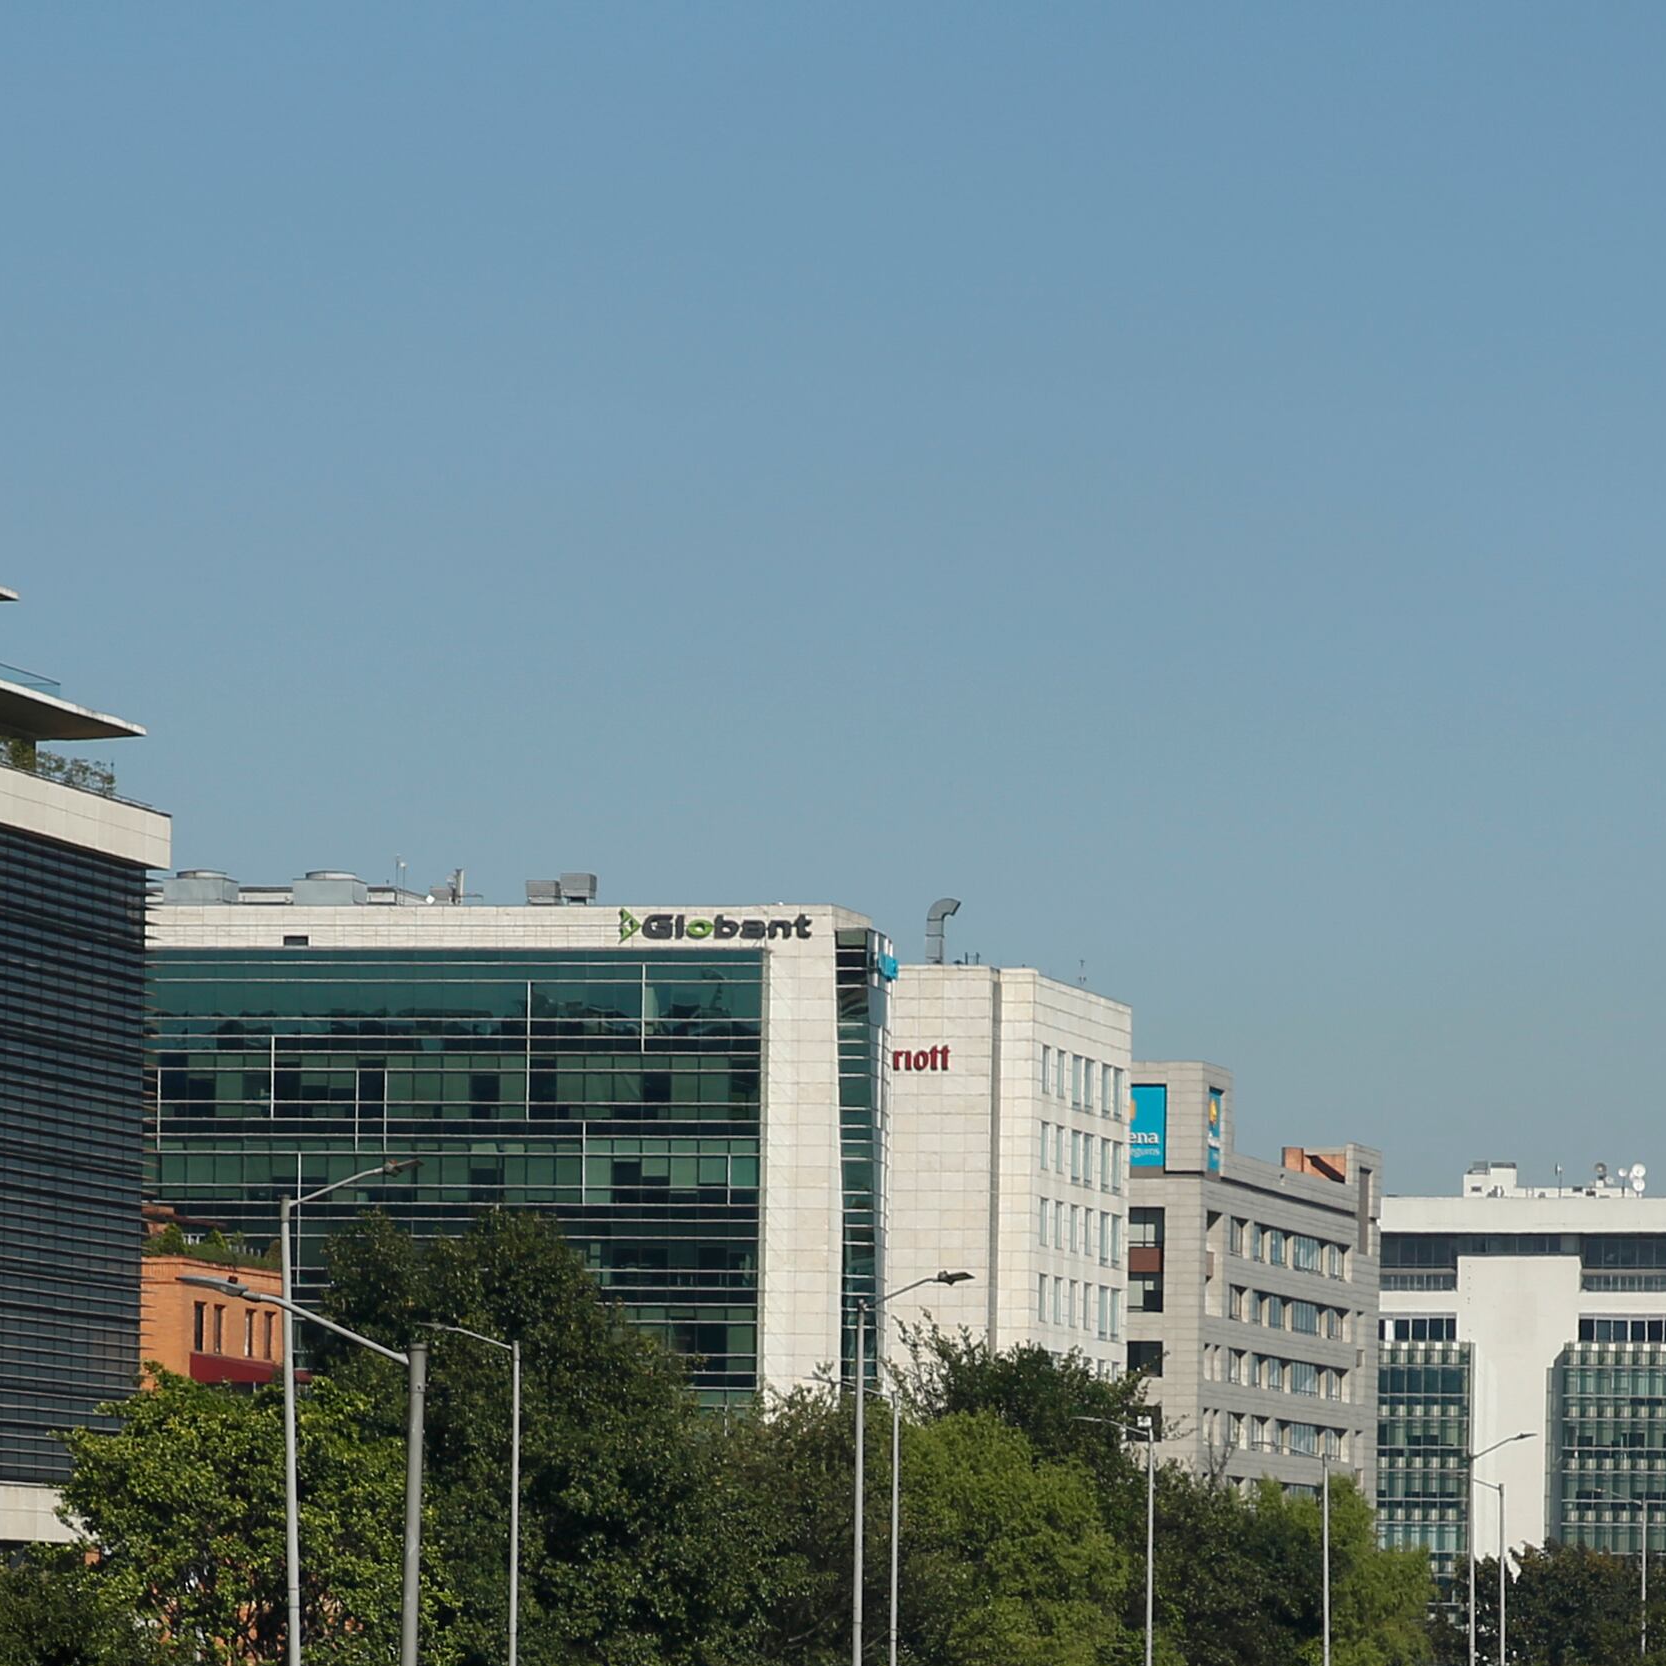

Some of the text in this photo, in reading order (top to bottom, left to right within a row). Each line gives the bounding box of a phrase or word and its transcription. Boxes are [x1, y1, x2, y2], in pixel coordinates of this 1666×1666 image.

[642, 914, 812, 939] Globant
[892, 1044, 950, 1071] riott
[1129, 1132, 1159, 1144] ena
